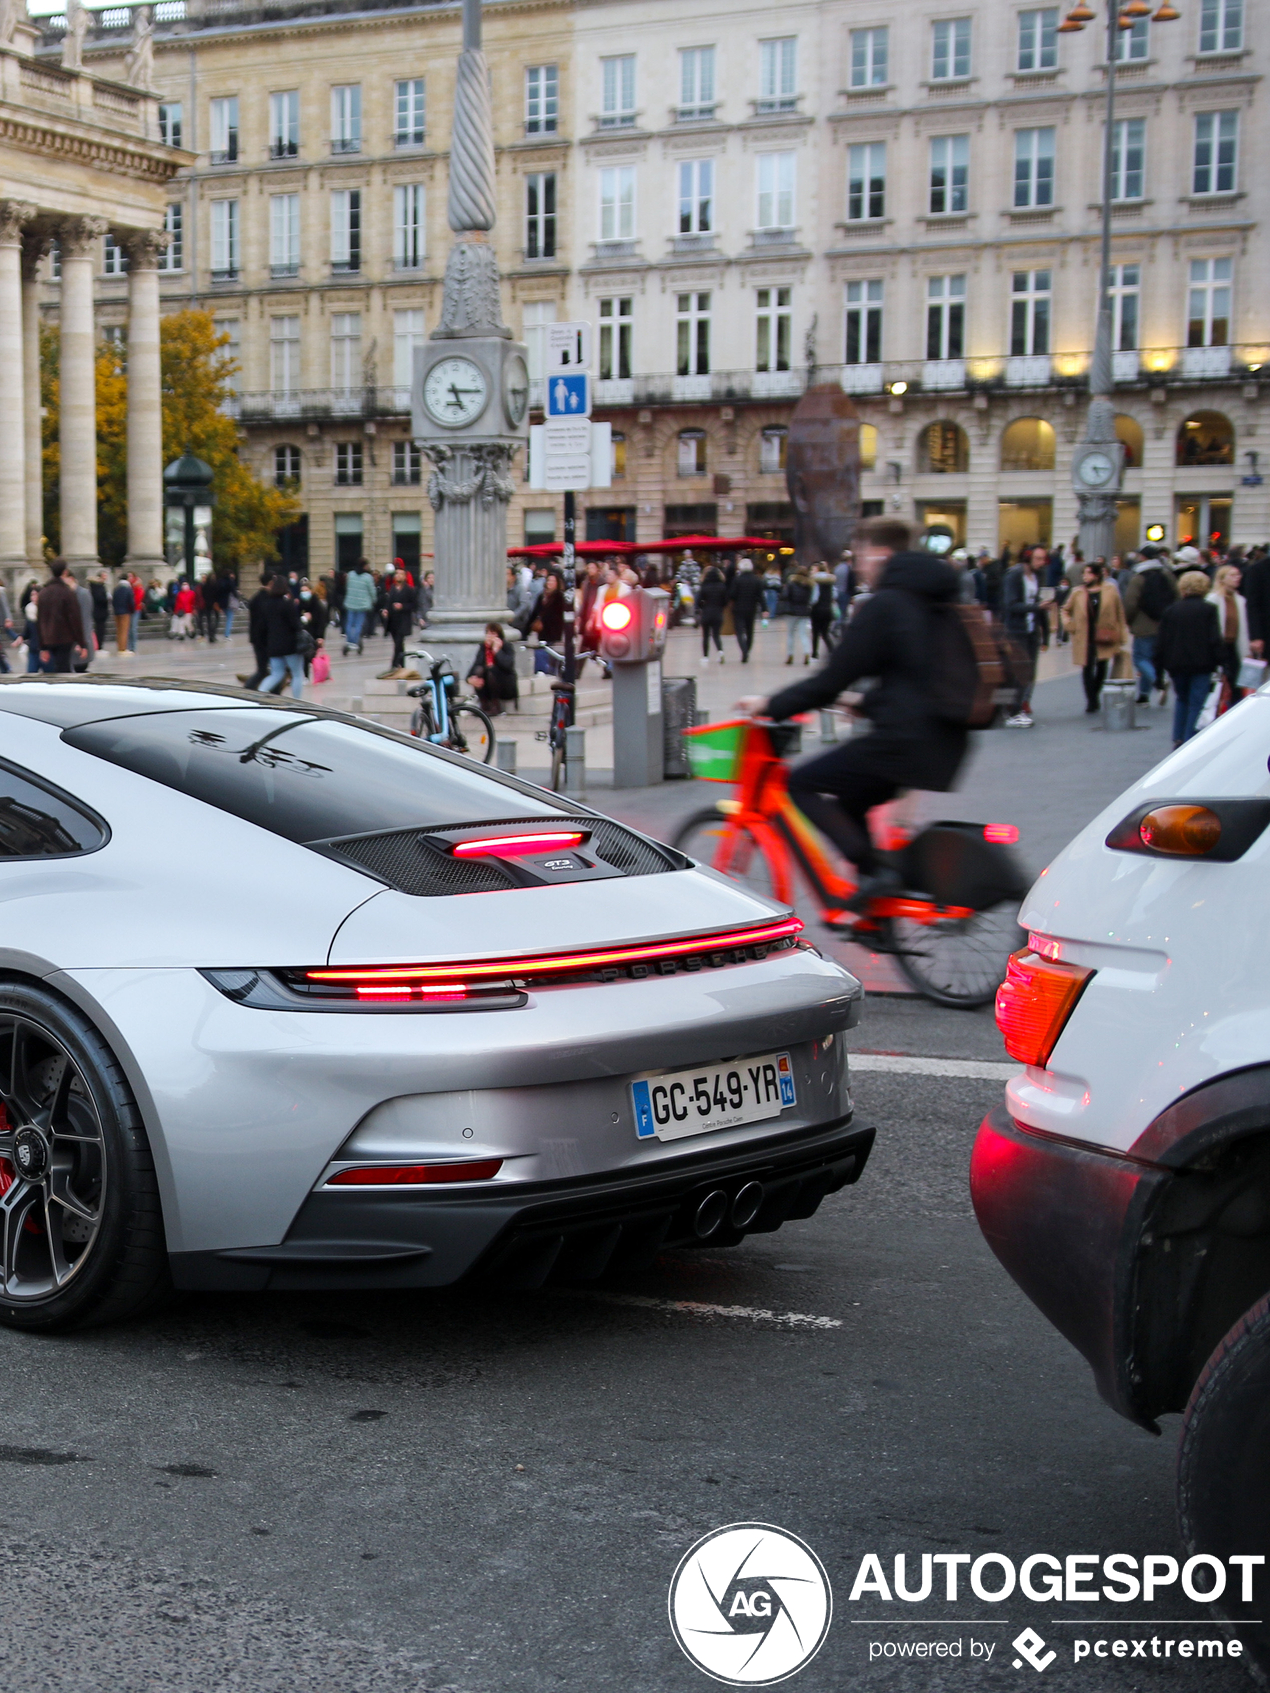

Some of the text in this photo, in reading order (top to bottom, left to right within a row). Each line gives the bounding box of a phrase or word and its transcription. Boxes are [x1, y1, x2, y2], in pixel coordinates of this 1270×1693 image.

[544, 859, 571, 868] GT3
[601, 946, 768, 983] PORSCHE
[651, 1064, 779, 1125] GC-549-YR
[782, 1082, 793, 1101] 14
[641, 1114, 648, 1127] F
